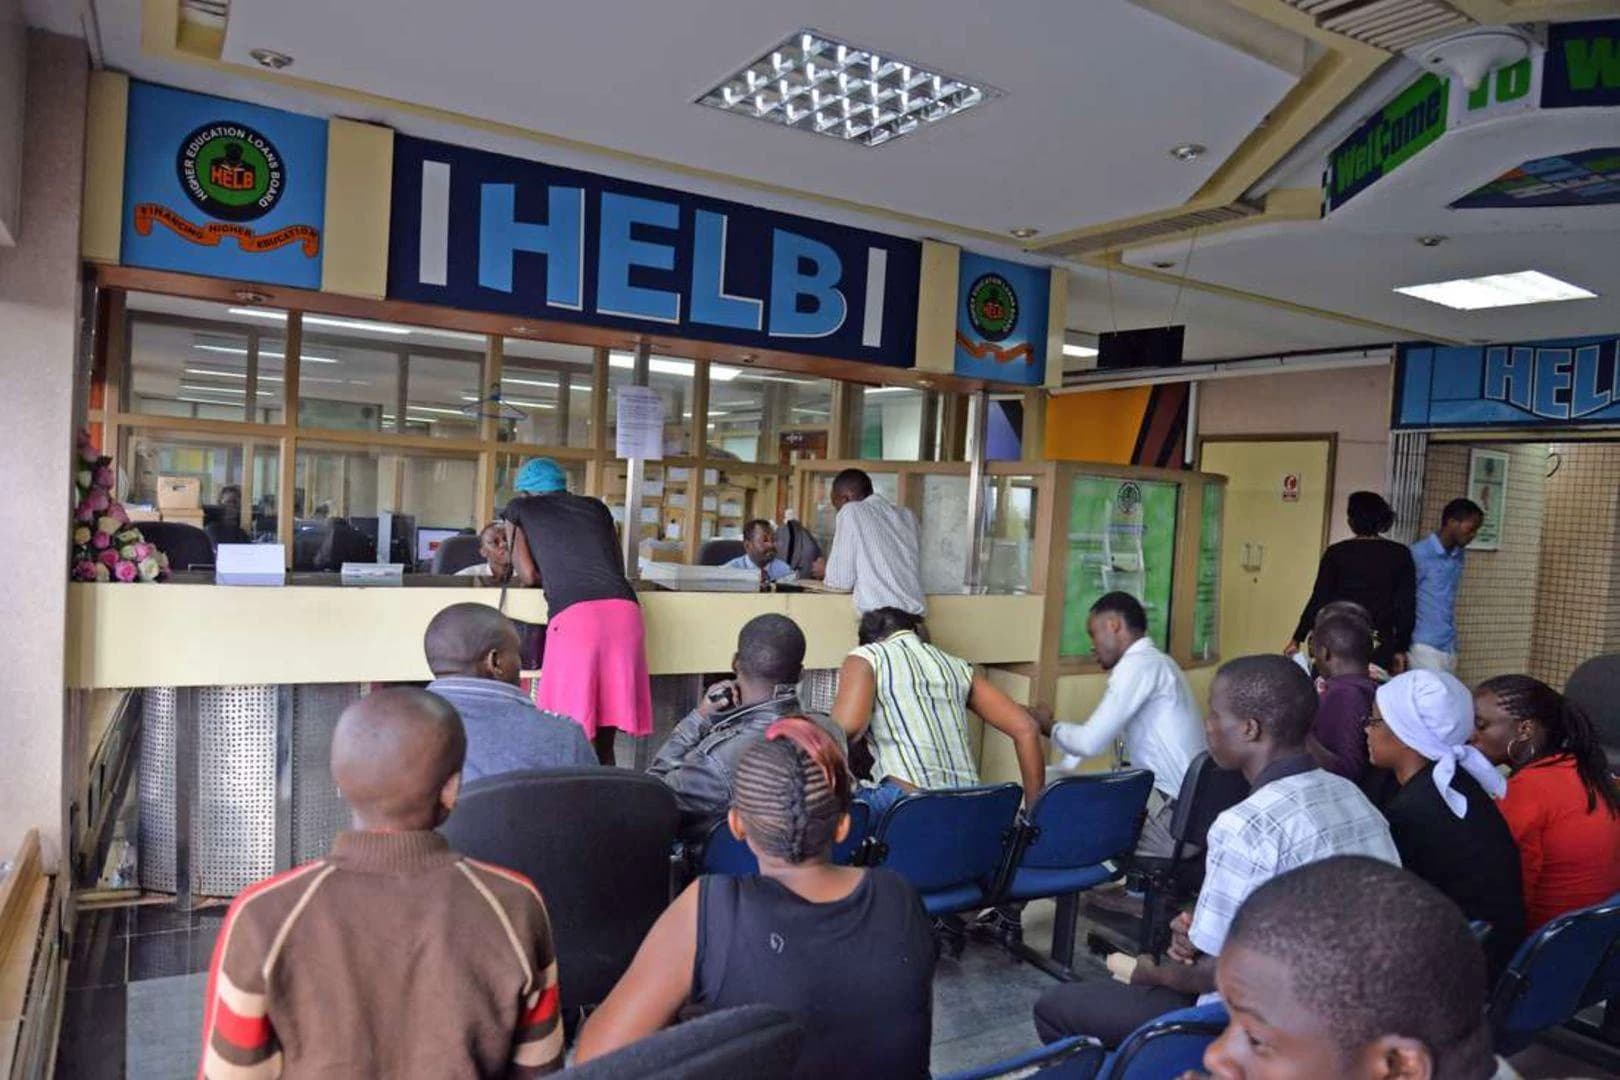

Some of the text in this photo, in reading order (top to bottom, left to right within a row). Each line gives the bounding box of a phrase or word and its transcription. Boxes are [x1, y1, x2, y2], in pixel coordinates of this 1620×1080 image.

[184, 127, 281, 208] HIGHER EDUCATION LOANS BOARD
[211, 163, 254, 189] HELB
[140, 205, 318, 249] FINANCING HIGHER EDUCATION
[478, 182, 848, 338] HELB
[1483, 339, 1620, 420] HEL
